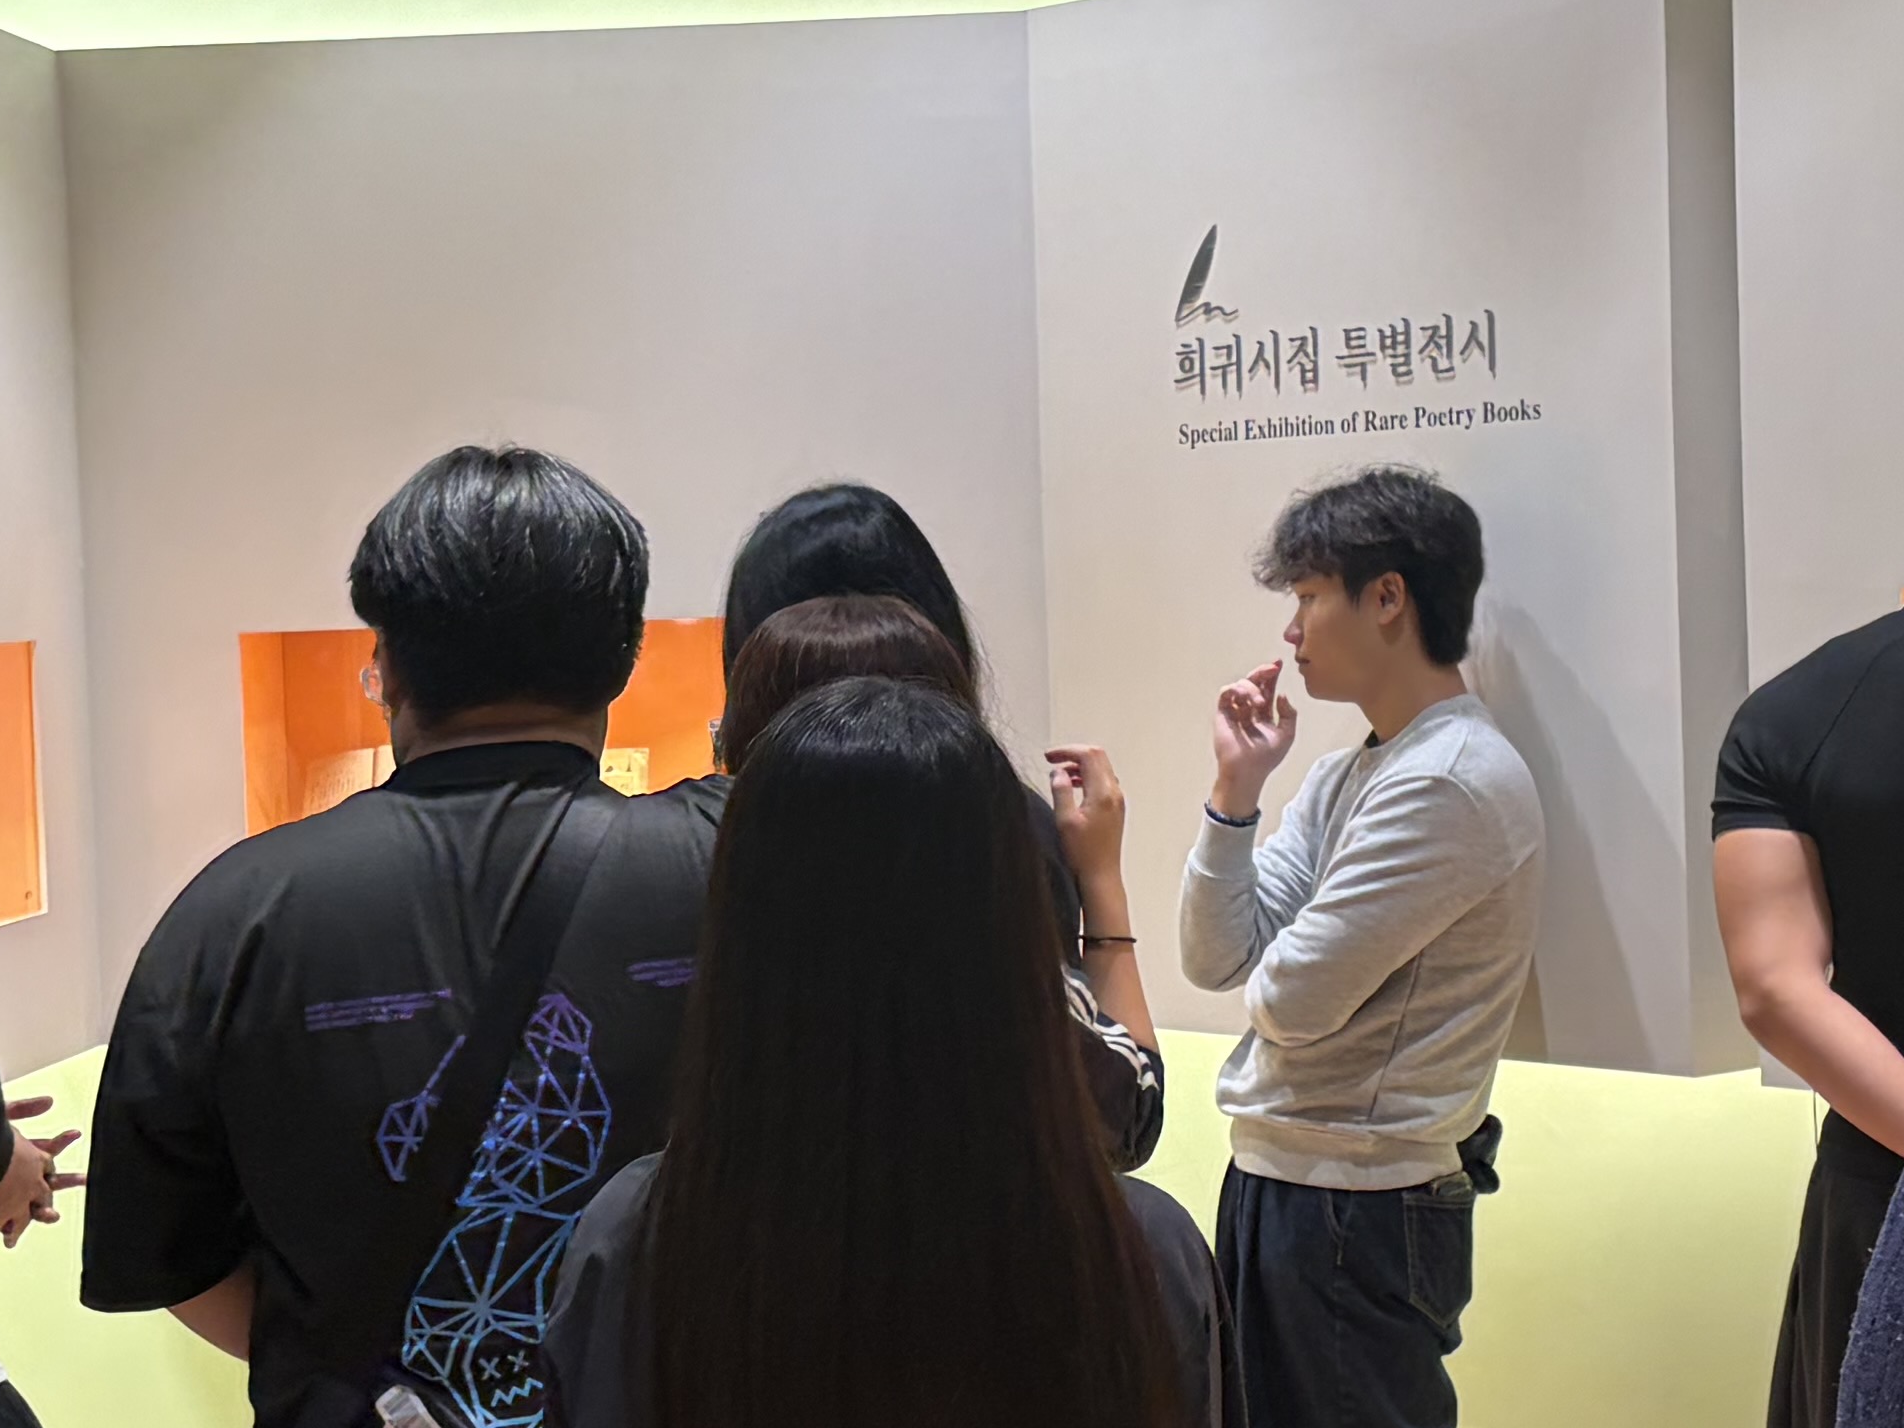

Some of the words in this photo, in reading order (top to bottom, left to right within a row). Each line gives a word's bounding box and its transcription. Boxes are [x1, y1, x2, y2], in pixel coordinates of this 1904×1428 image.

[1174, 326, 1319, 399] 희귀시집
[1334, 308, 1497, 386] 특별전시
[1178, 420, 1238, 449] Special
[1244, 414, 1335, 441] Exhibition
[1340, 411, 1360, 434] of
[1364, 409, 1408, 432] Rare
[1414, 406, 1476, 430] Poetry
[1482, 398, 1542, 424] Books
